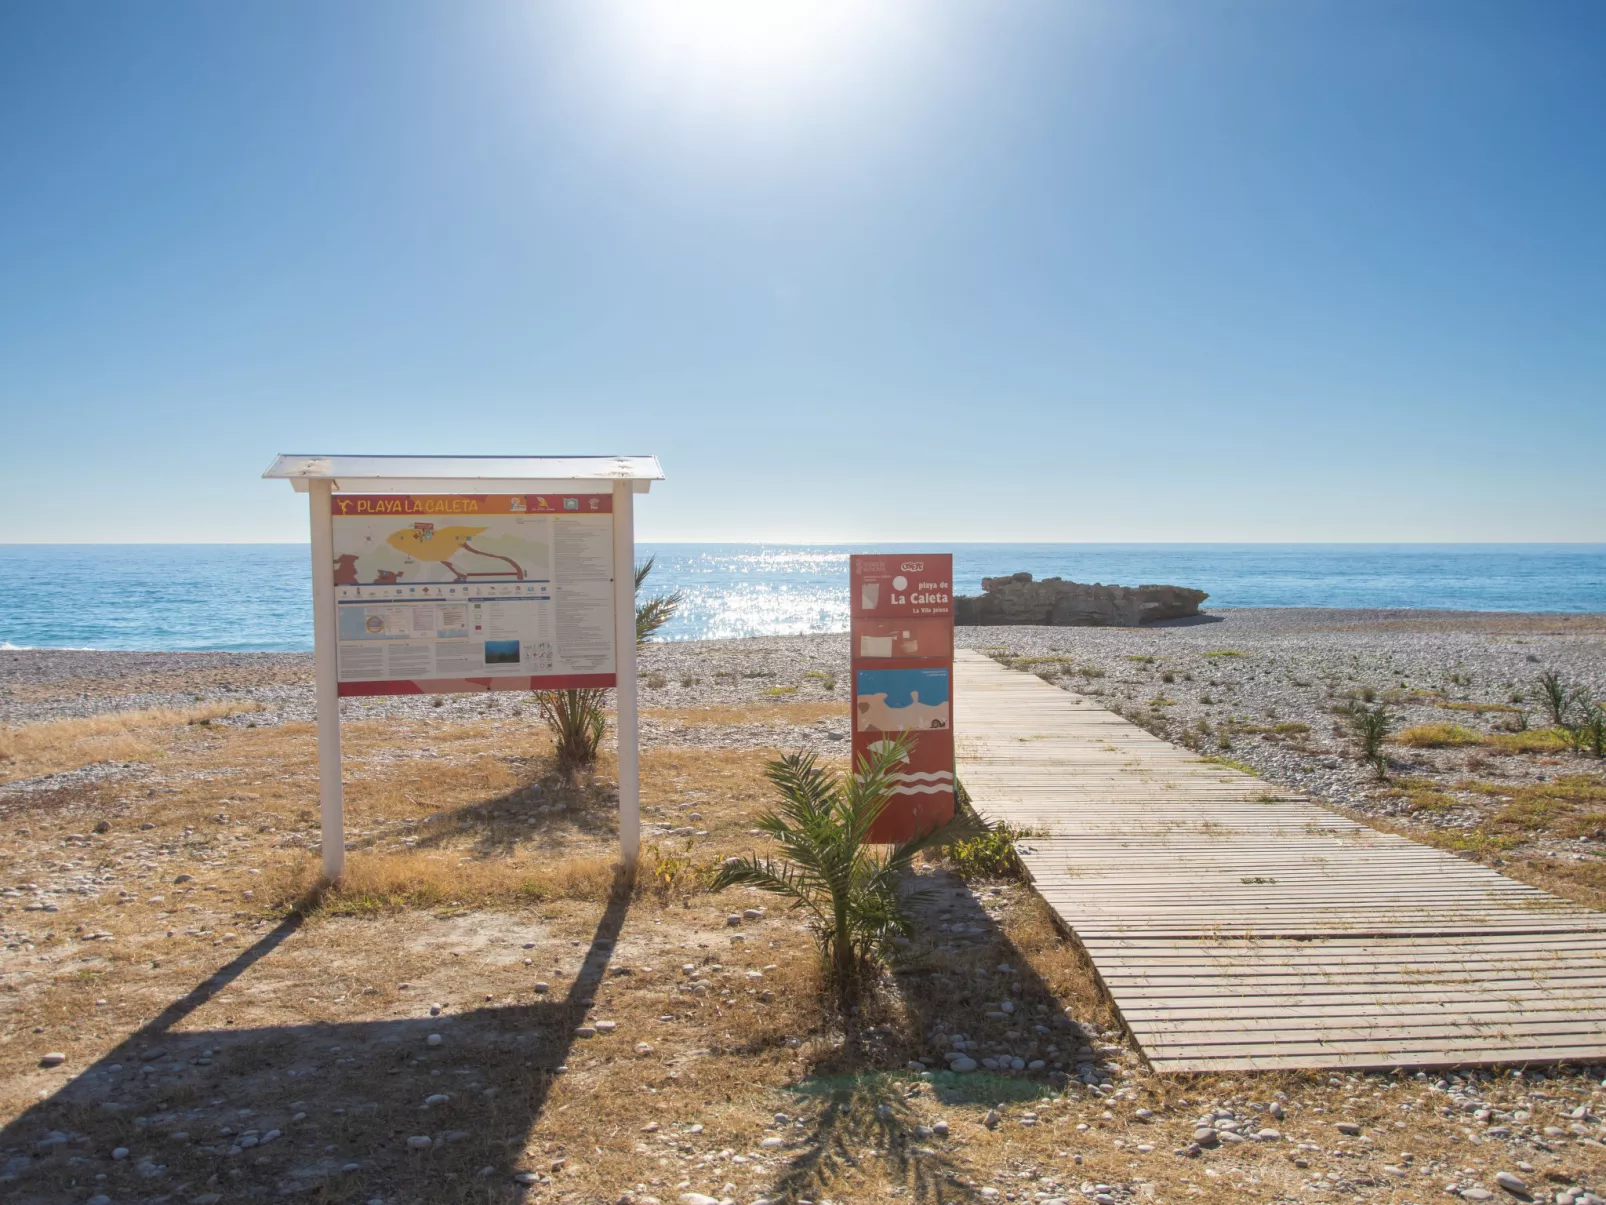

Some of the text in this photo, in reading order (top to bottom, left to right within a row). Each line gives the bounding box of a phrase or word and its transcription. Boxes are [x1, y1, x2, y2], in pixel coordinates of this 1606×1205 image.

[357, 500, 479, 512] PLAYA LA CALETA
[918, 581, 948, 591] playa de
[891, 592, 948, 605] La Caleta
